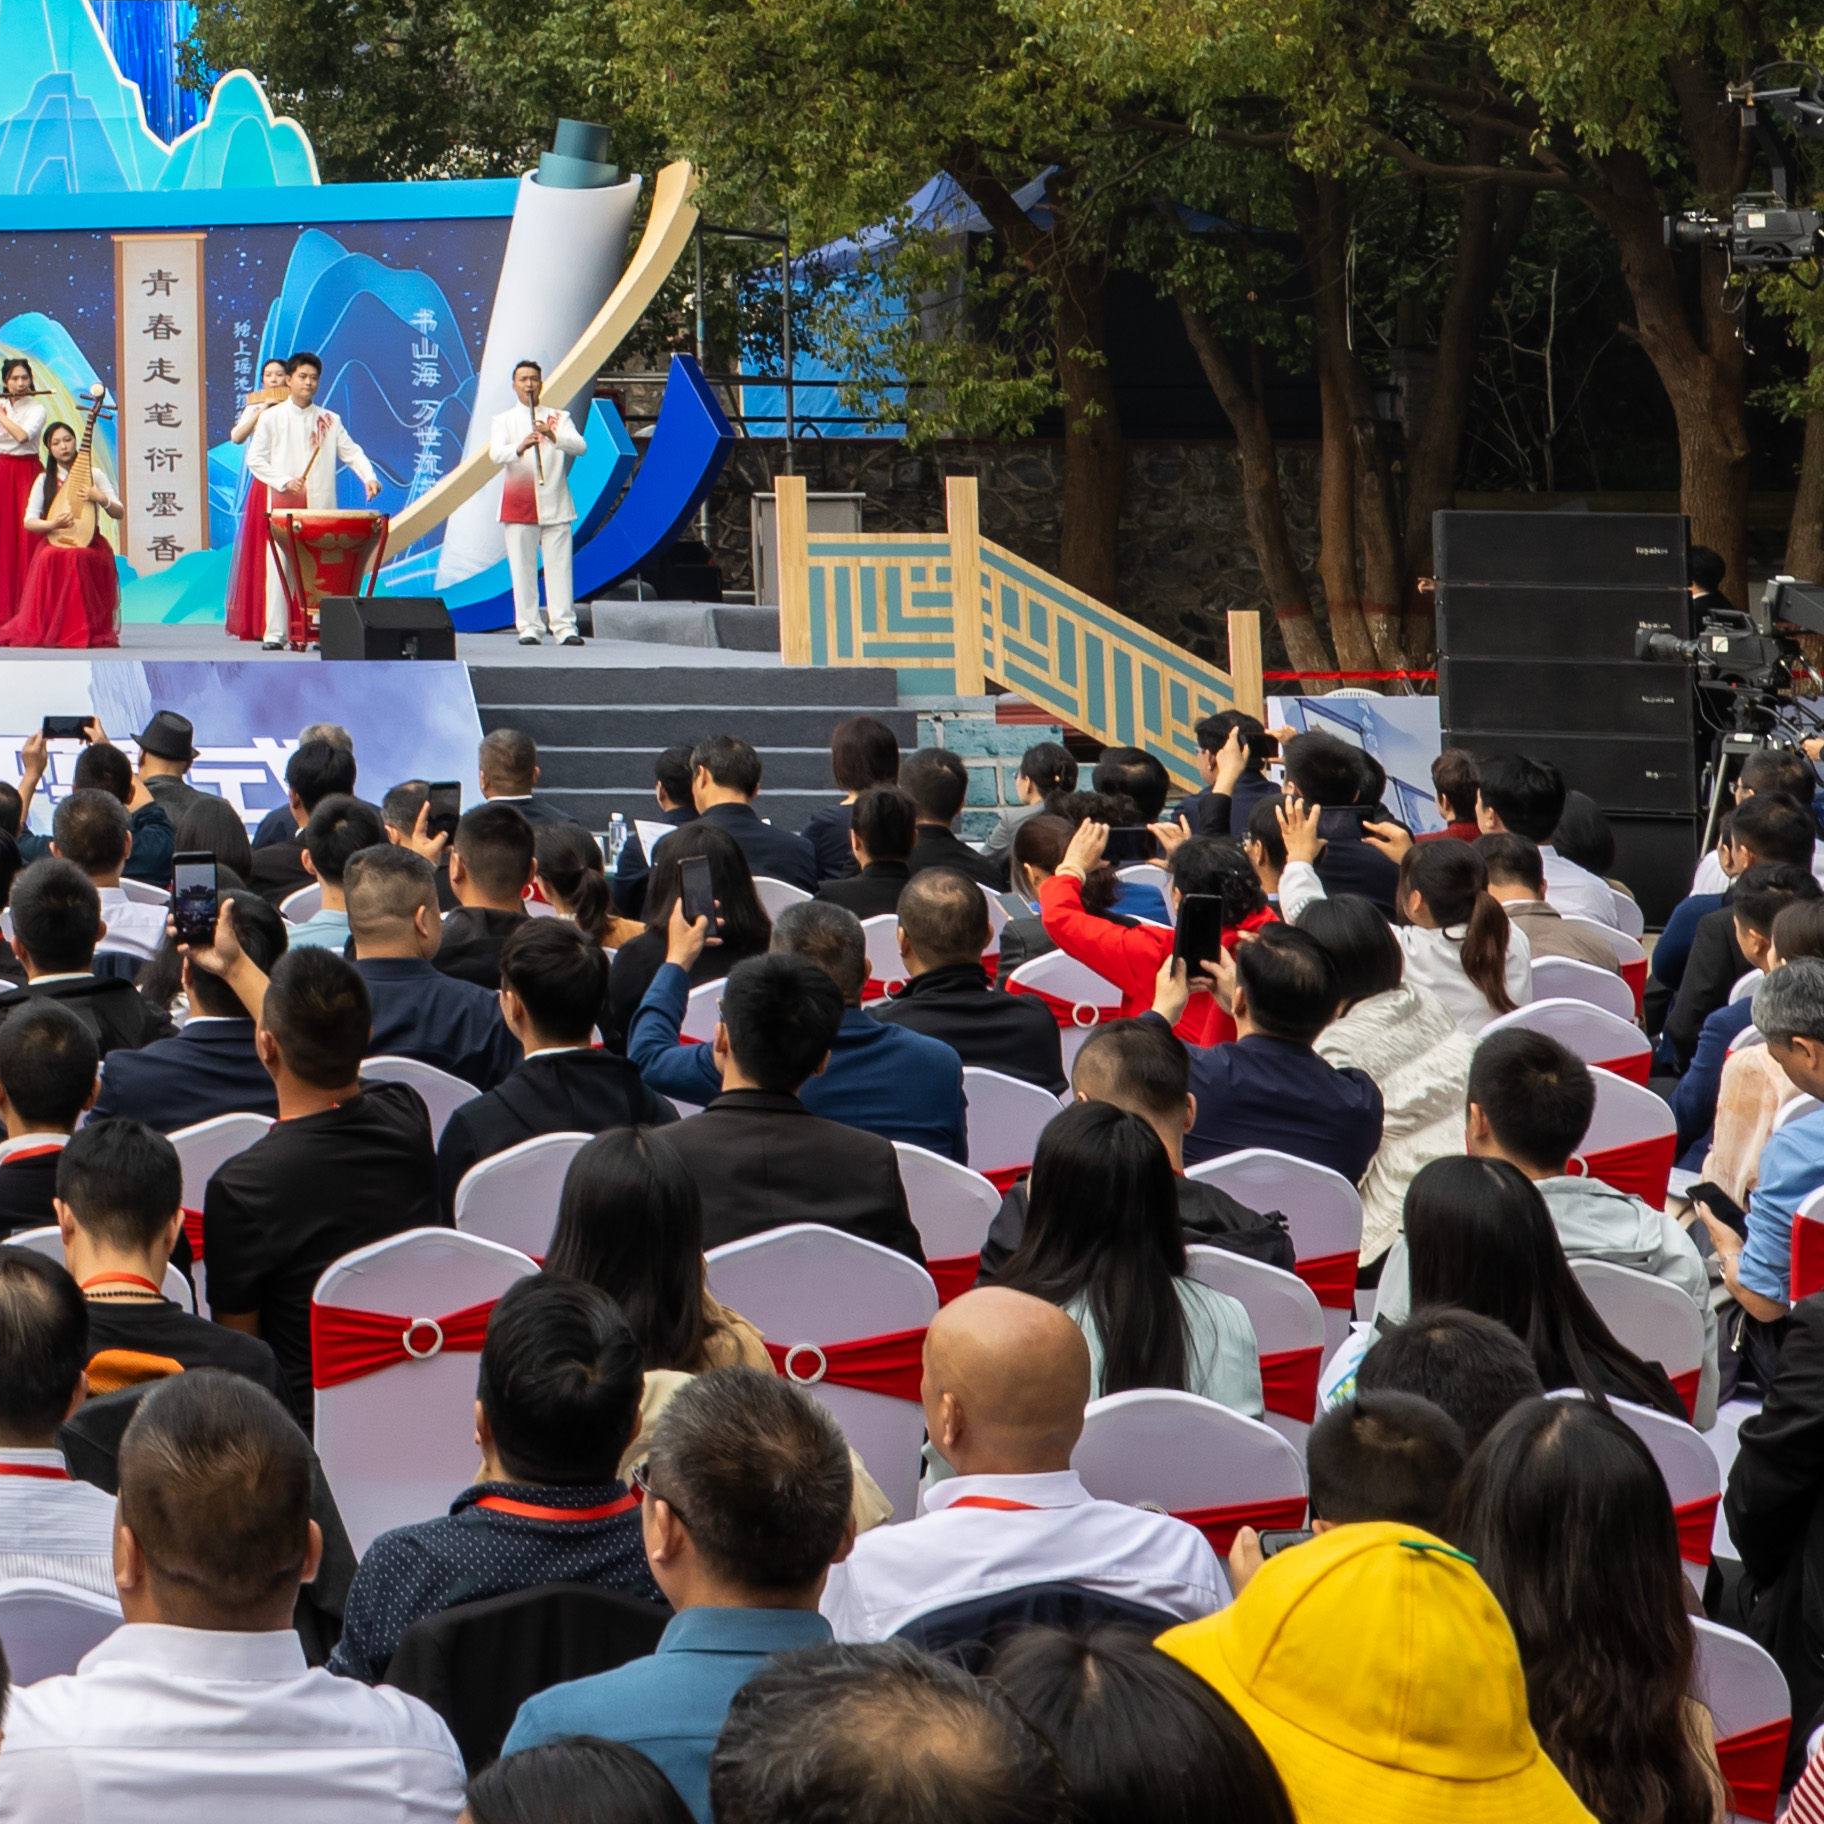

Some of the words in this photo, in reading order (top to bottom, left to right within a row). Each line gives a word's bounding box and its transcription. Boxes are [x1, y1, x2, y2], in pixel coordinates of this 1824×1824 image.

[141, 269, 185, 562] 青春走笔衍墨香
